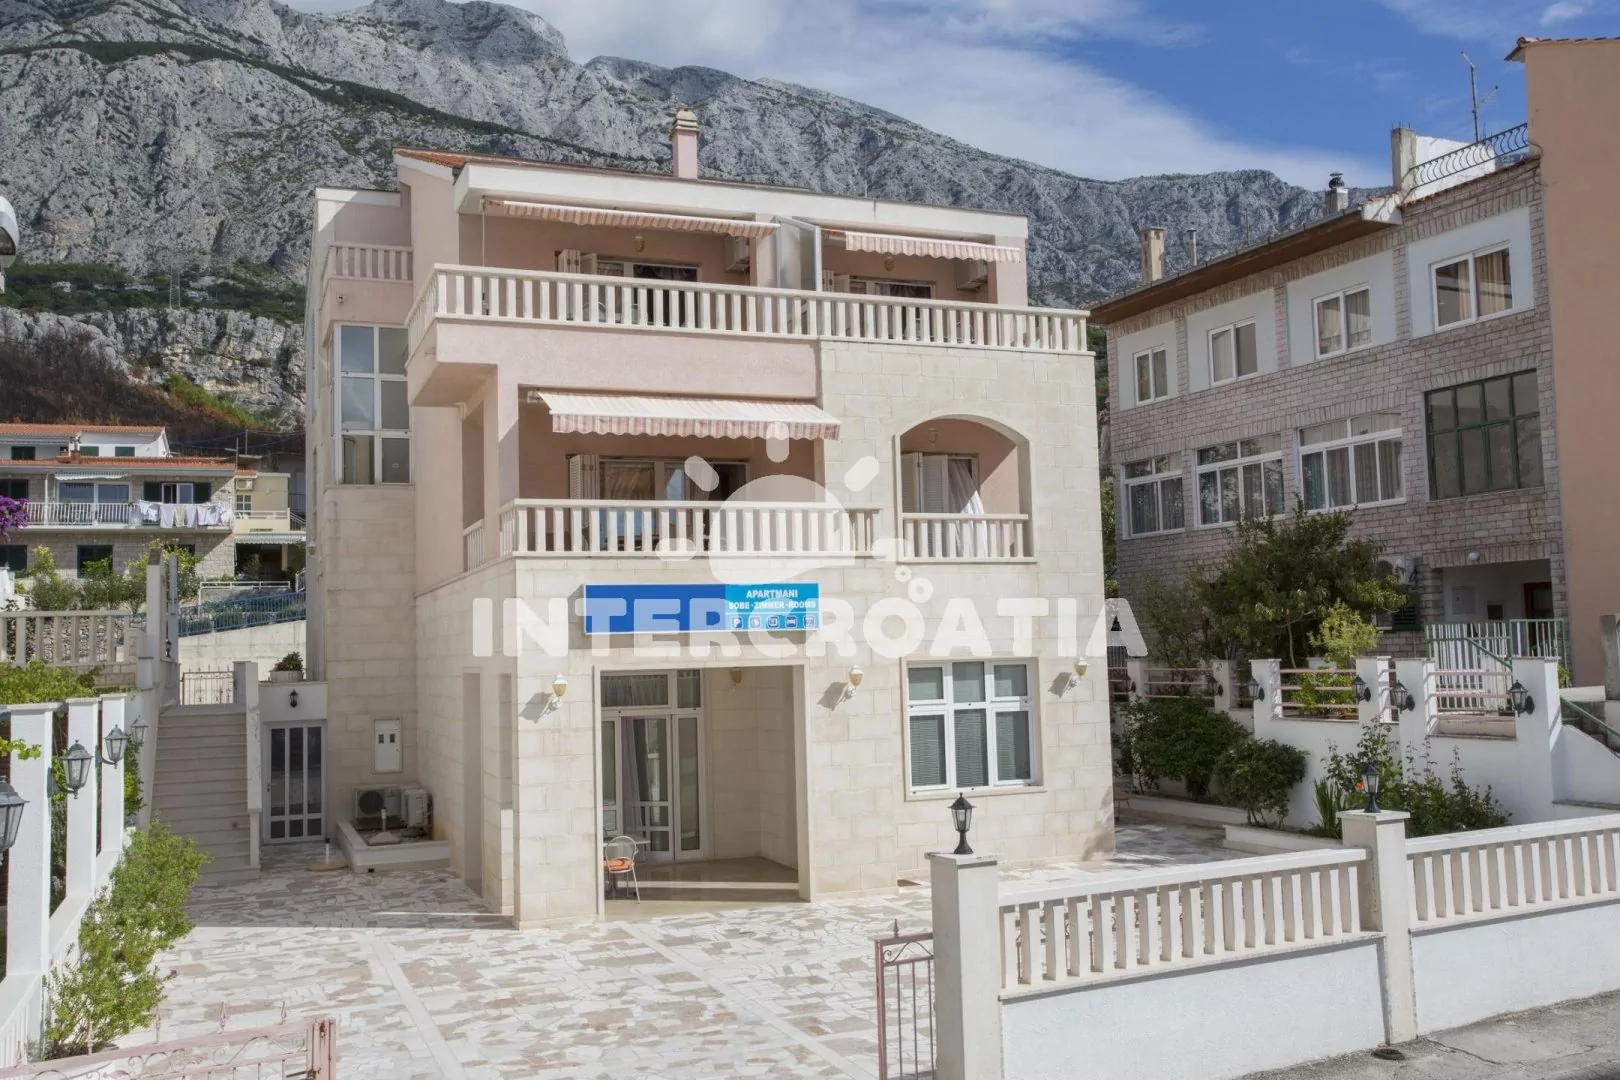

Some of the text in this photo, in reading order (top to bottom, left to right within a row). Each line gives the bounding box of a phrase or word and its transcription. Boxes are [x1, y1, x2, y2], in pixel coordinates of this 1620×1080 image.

[746, 589, 798, 598] APARTMANI
[728, 600, 816, 609] SOBE ZIMMER ROOMS
